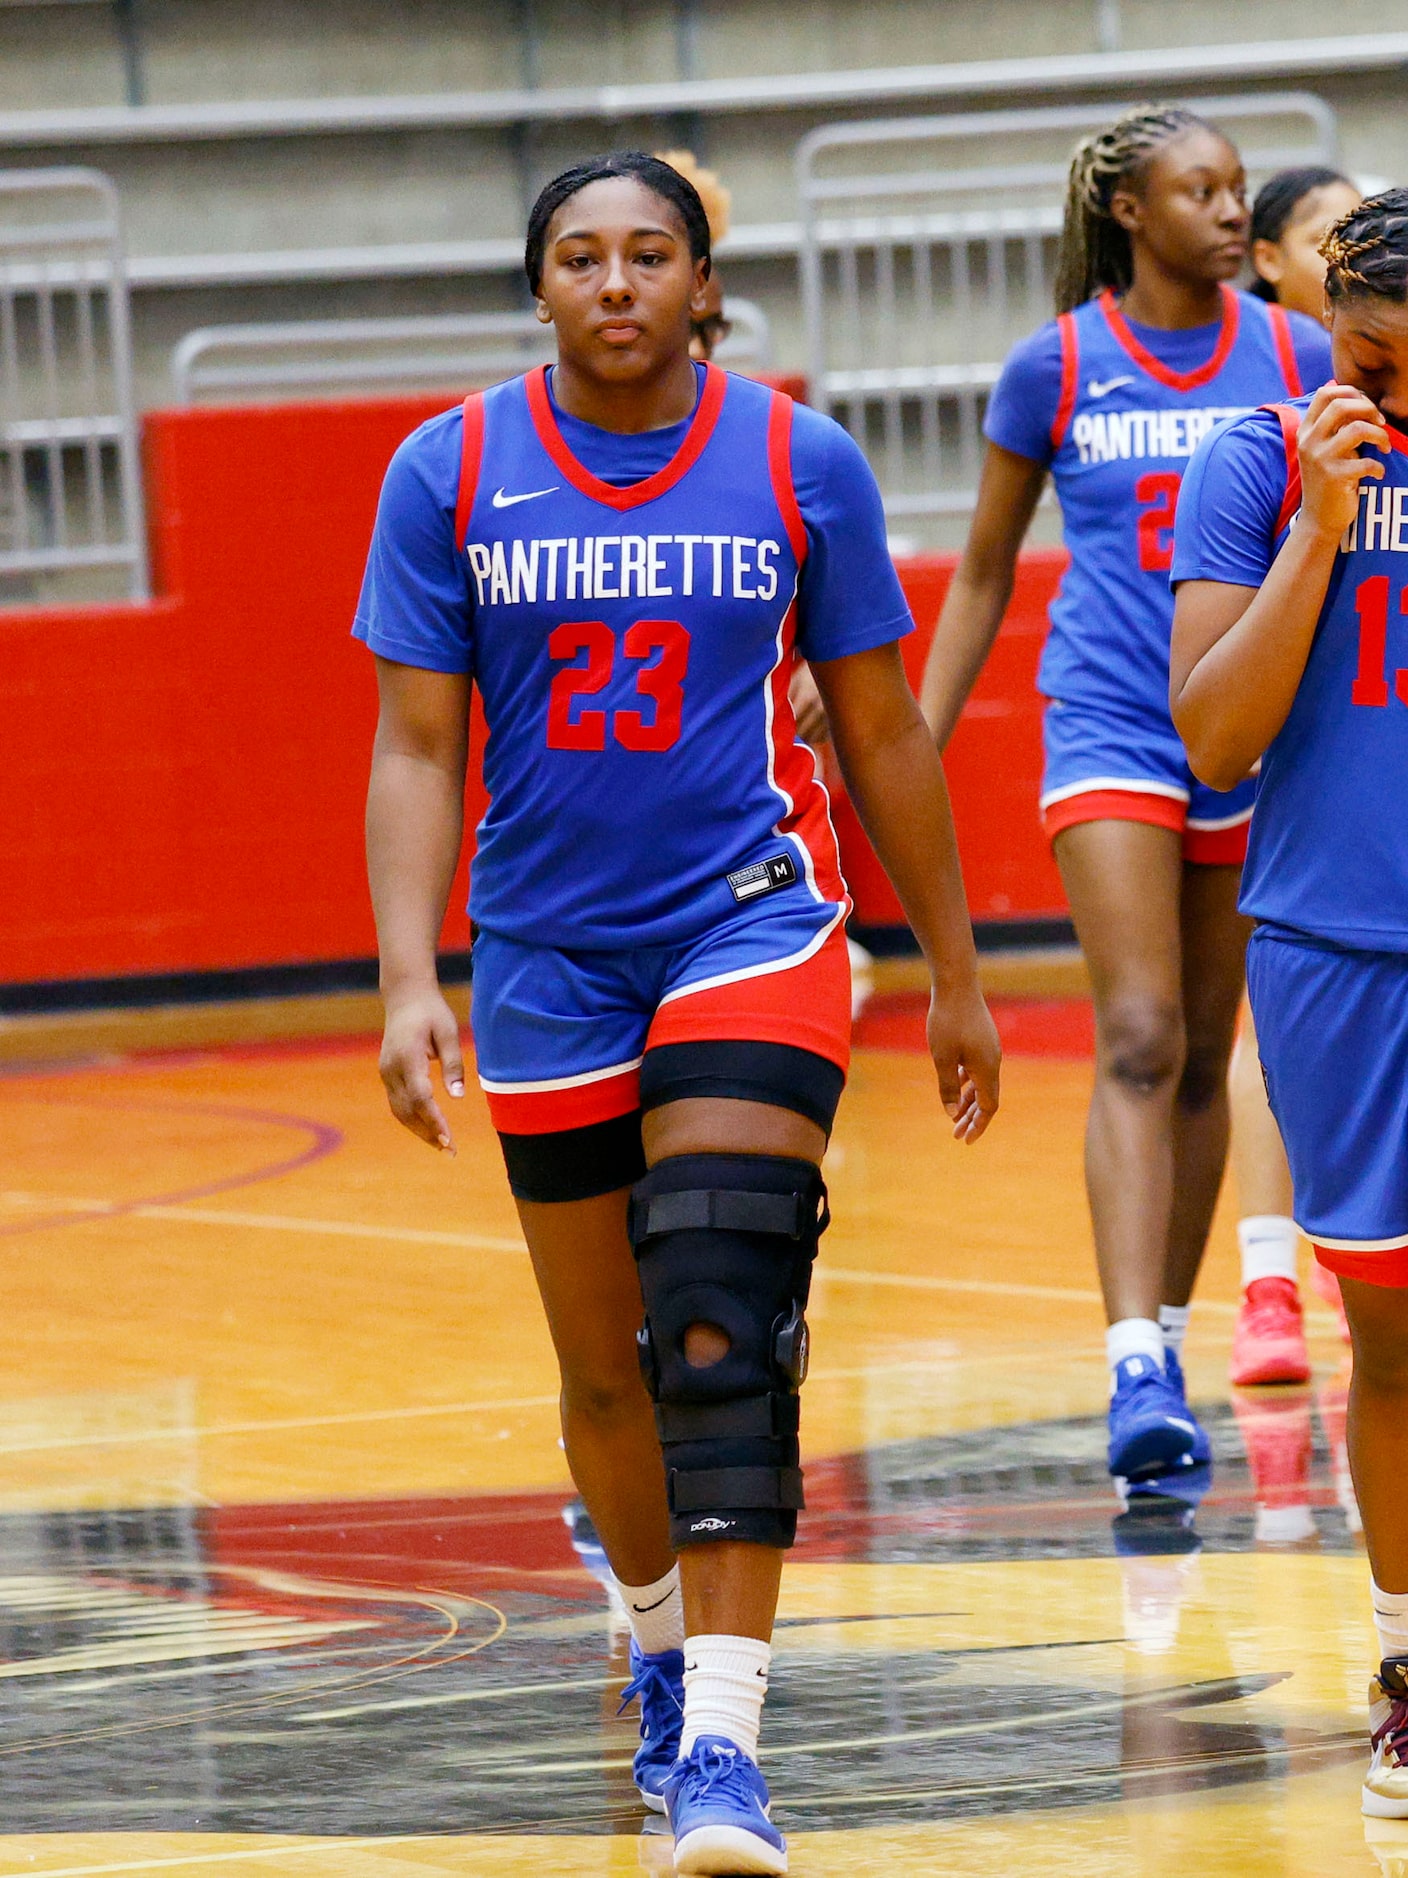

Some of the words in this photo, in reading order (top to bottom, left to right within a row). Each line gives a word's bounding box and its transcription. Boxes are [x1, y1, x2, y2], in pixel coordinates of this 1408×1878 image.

[467, 534, 780, 606] PANTHERETTES
[547, 620, 691, 752] 23
[774, 863, 787, 878] M
